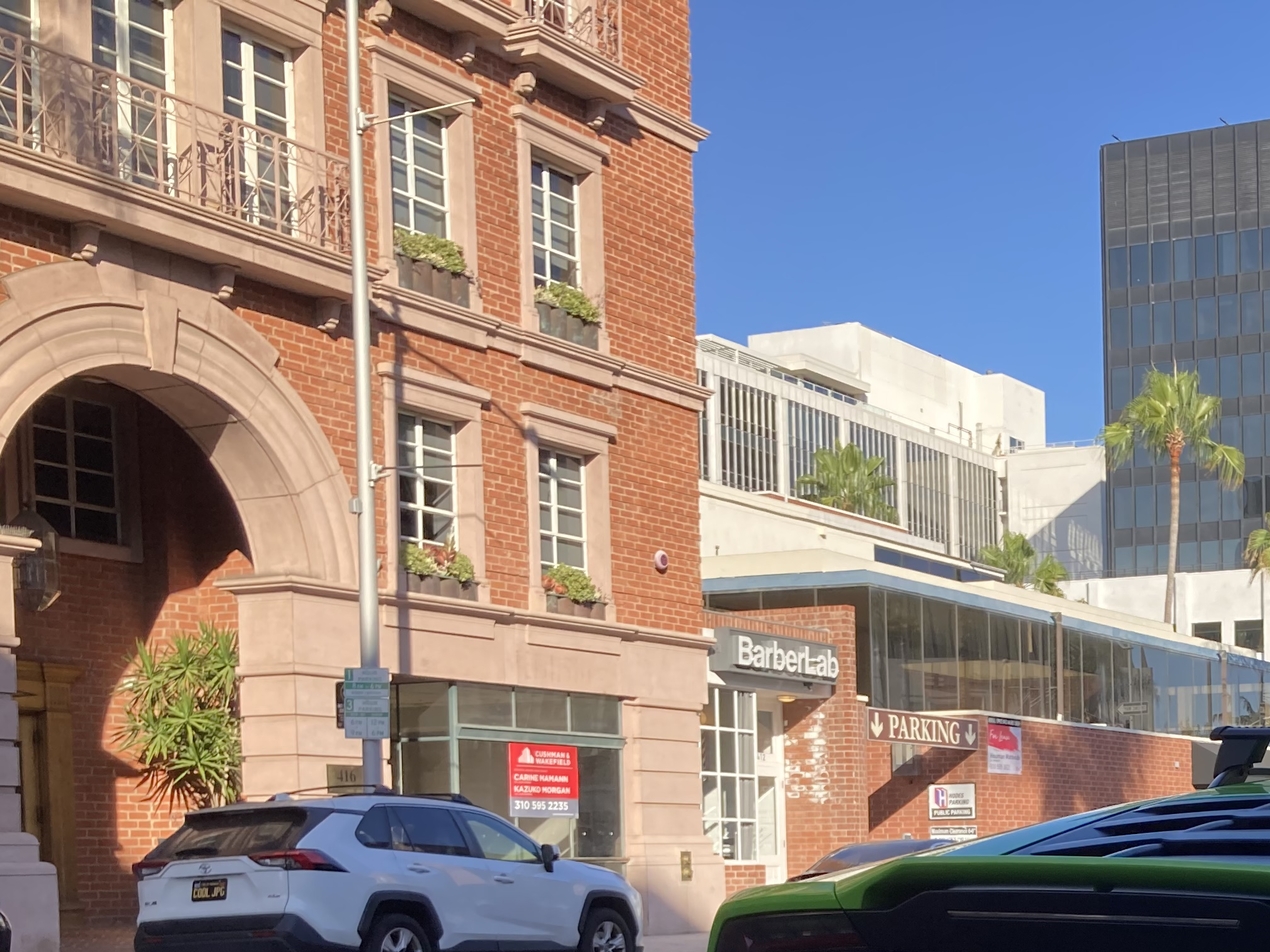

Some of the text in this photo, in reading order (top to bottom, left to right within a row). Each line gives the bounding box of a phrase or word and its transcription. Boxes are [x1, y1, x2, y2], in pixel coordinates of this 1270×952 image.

[738, 635, 839, 678] BarberLab
[346, 700, 353, 711] 3
[888, 714, 960, 745] PARKING
[535, 750, 565, 758] CUSHMAN
[535, 758, 571, 766] WAKEFIELD
[337, 770, 356, 782] 416
[514, 785, 571, 794] KAZUKO MORGAN
[514, 800, 568, 810] 310 595 2235
[193, 888, 210, 898] COOL
